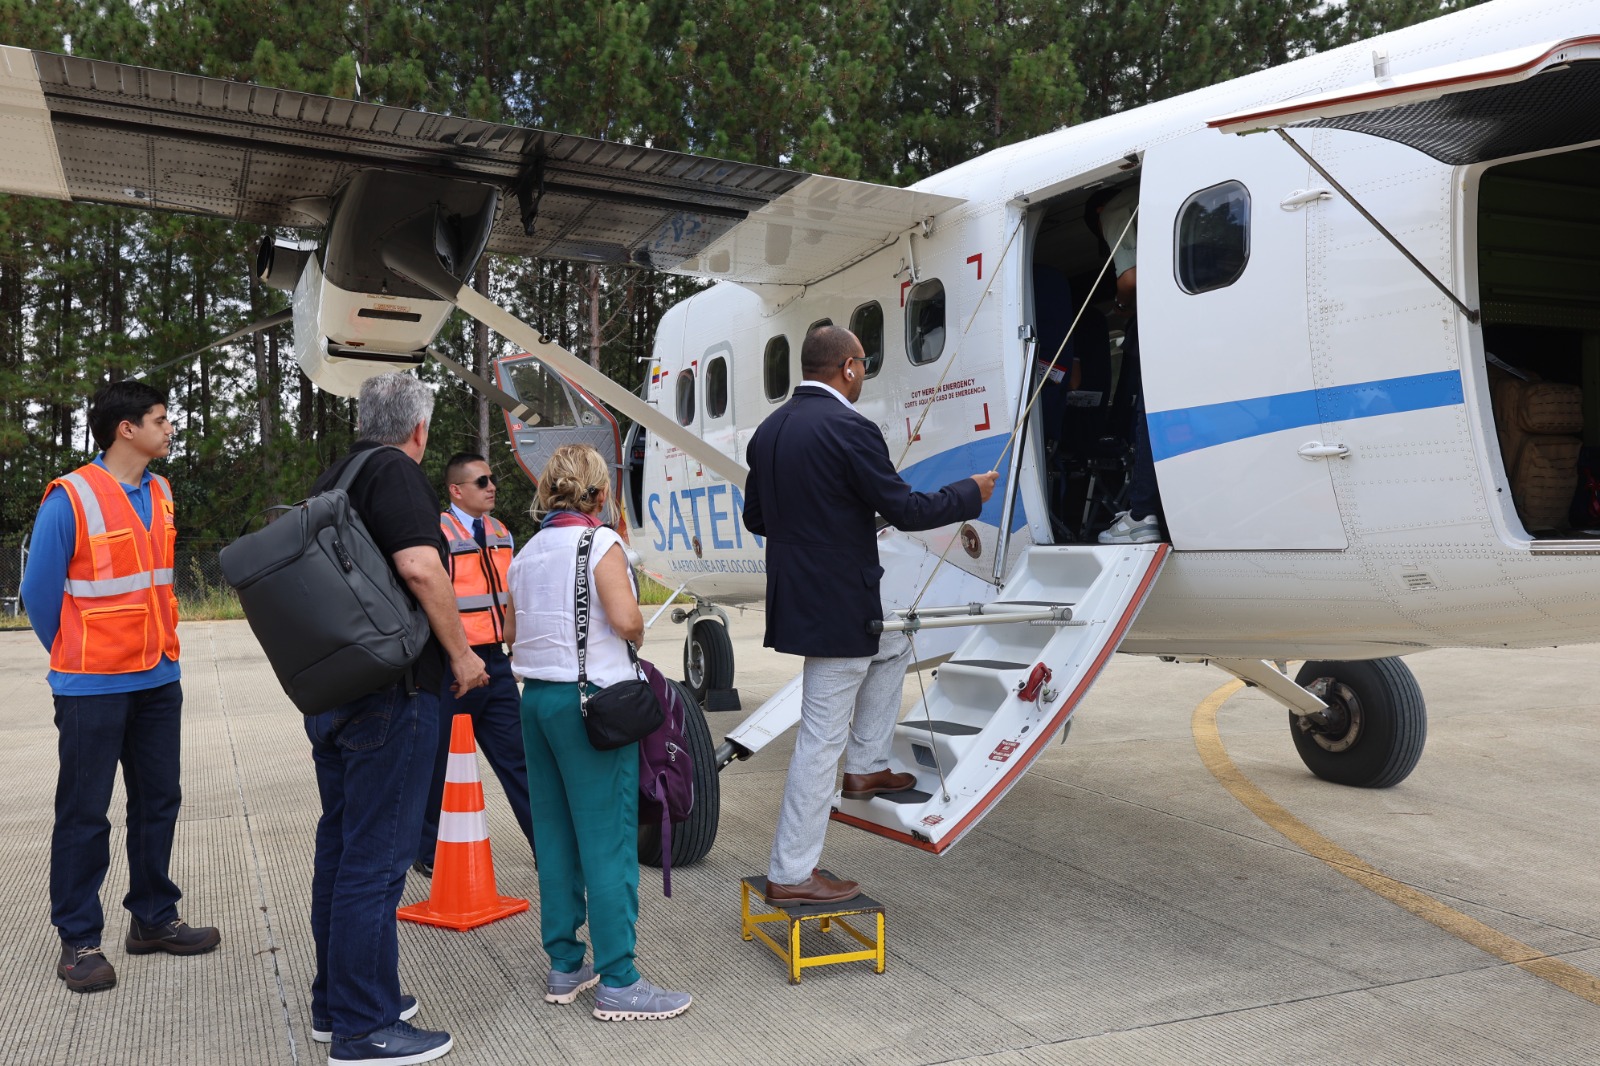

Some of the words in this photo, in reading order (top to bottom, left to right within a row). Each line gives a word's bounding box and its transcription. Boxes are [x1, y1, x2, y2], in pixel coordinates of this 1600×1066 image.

[922, 387, 935, 396] HERE
[943, 378, 975, 392] EMERGENCY
[936, 394, 948, 402] CASO
[948, 392, 955, 400] DE
[955, 386, 986, 398] EMERGENCIA
